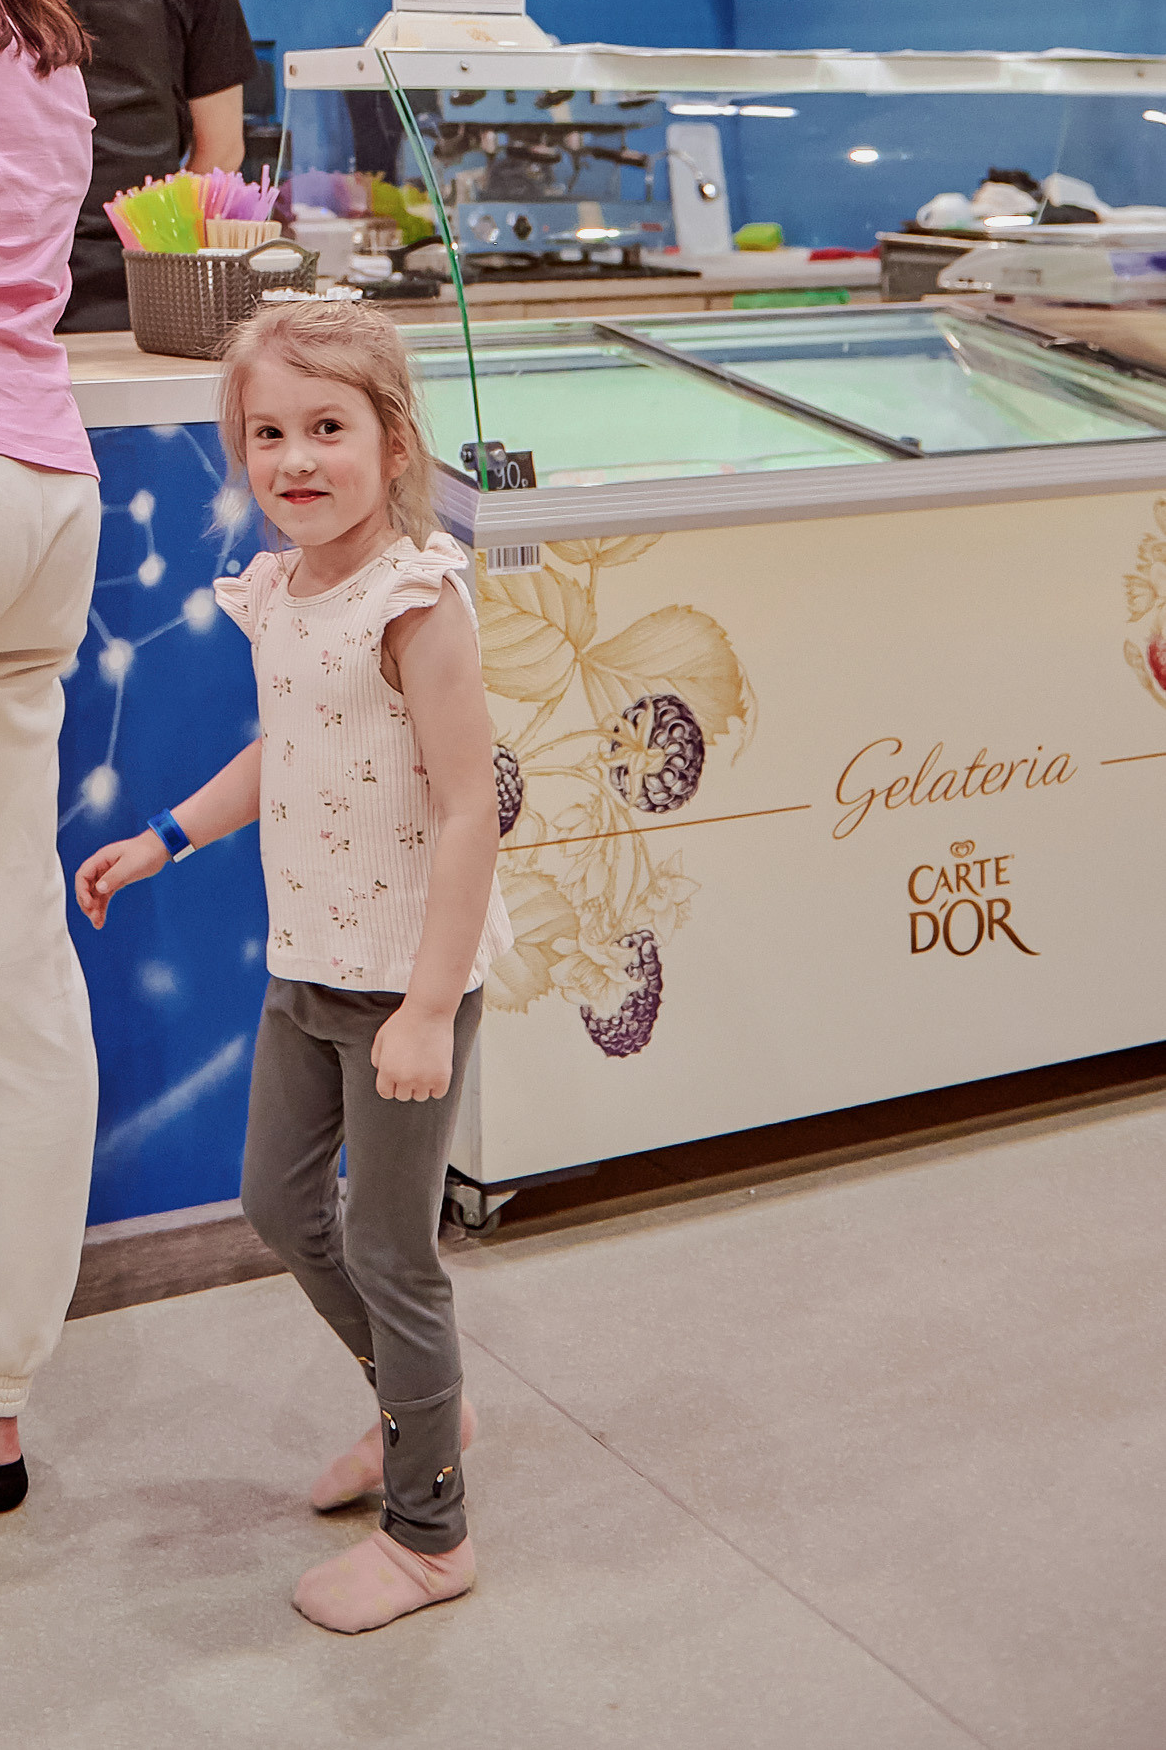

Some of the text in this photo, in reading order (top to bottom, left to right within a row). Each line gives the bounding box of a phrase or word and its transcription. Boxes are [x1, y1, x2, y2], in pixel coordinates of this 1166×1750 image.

[831, 736, 1079, 840] Gelateria
[907, 853, 1011, 906] CARTE
[908, 897, 1042, 957] D'OR
